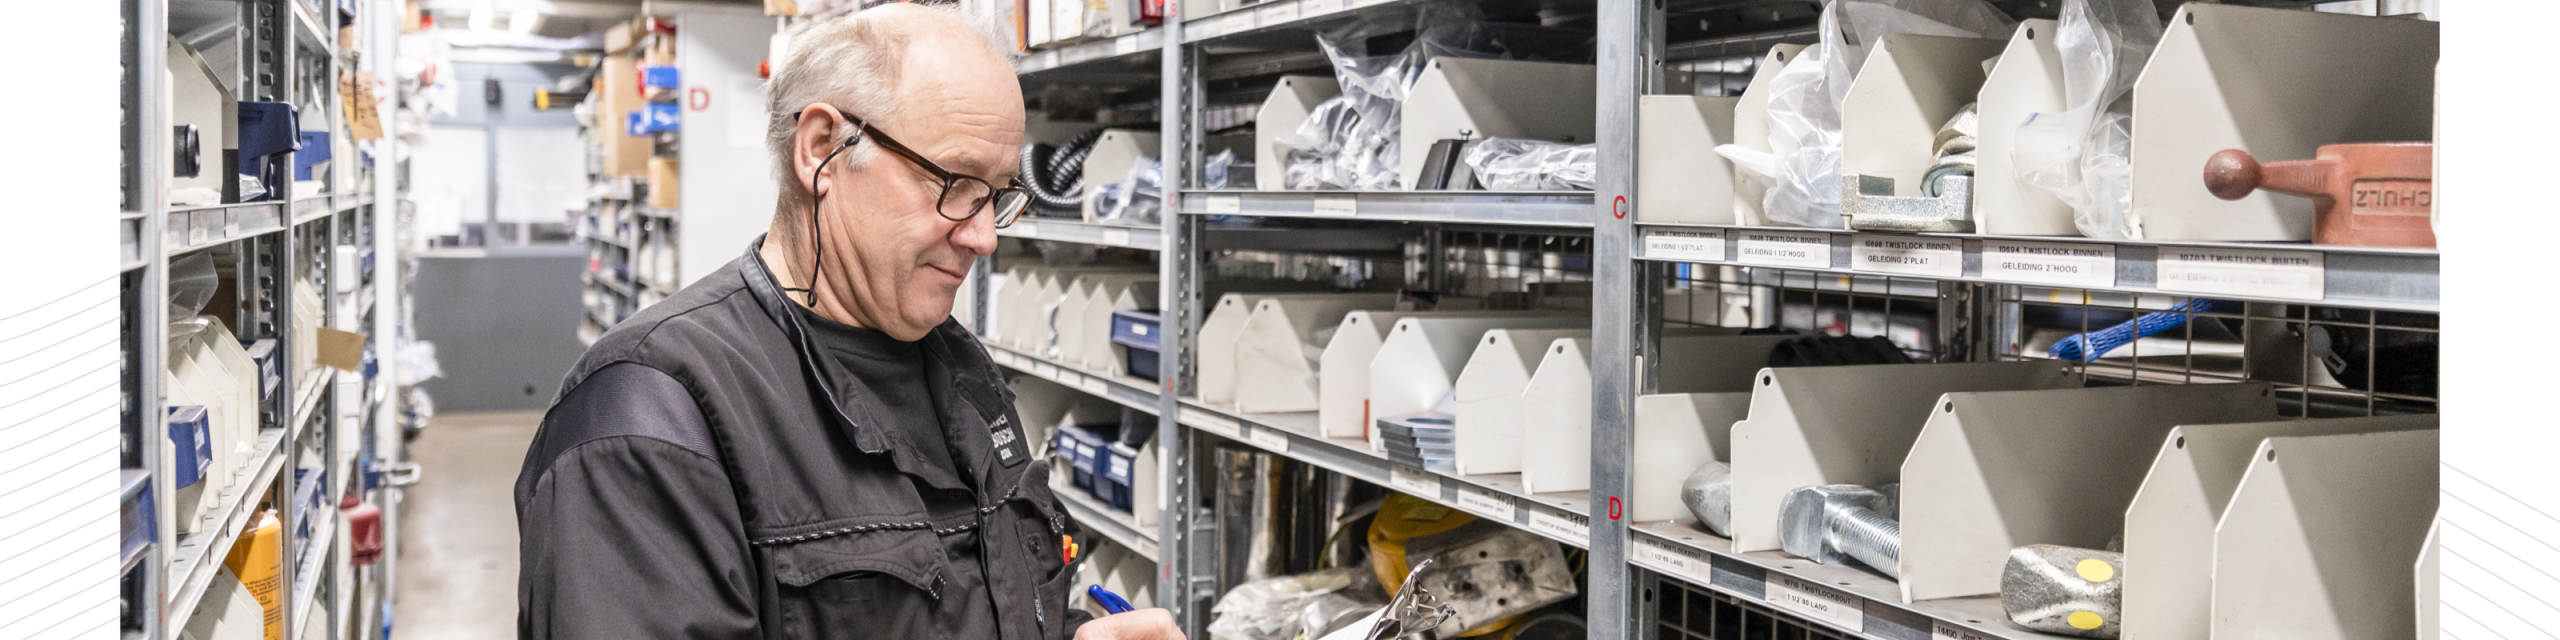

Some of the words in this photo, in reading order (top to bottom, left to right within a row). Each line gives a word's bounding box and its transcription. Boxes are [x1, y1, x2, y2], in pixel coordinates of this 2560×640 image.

[689, 87, 711, 112] D
[1613, 195, 1626, 219] C
[1766, 235, 1798, 243] TWISTLOCK
[1865, 240, 1882, 248] 10698
[1885, 241, 1924, 249] TWISTLOCK
[1744, 248, 1772, 256] GELEIDING
[2023, 247, 2069, 256] TWISTLOCK
[2073, 248, 2104, 257] BINNEN
[1868, 255, 1901, 264] GELEIDING
[2210, 255, 2267, 264] TWISTLOCK
[2272, 257, 2310, 266] BUITEN
[2002, 262, 2043, 271] GELEIDING
[1609, 495, 1622, 520] D
[1670, 557, 1684, 567] LANG
[1810, 601, 1828, 612] LANG
[1937, 626, 1957, 639] 14490
